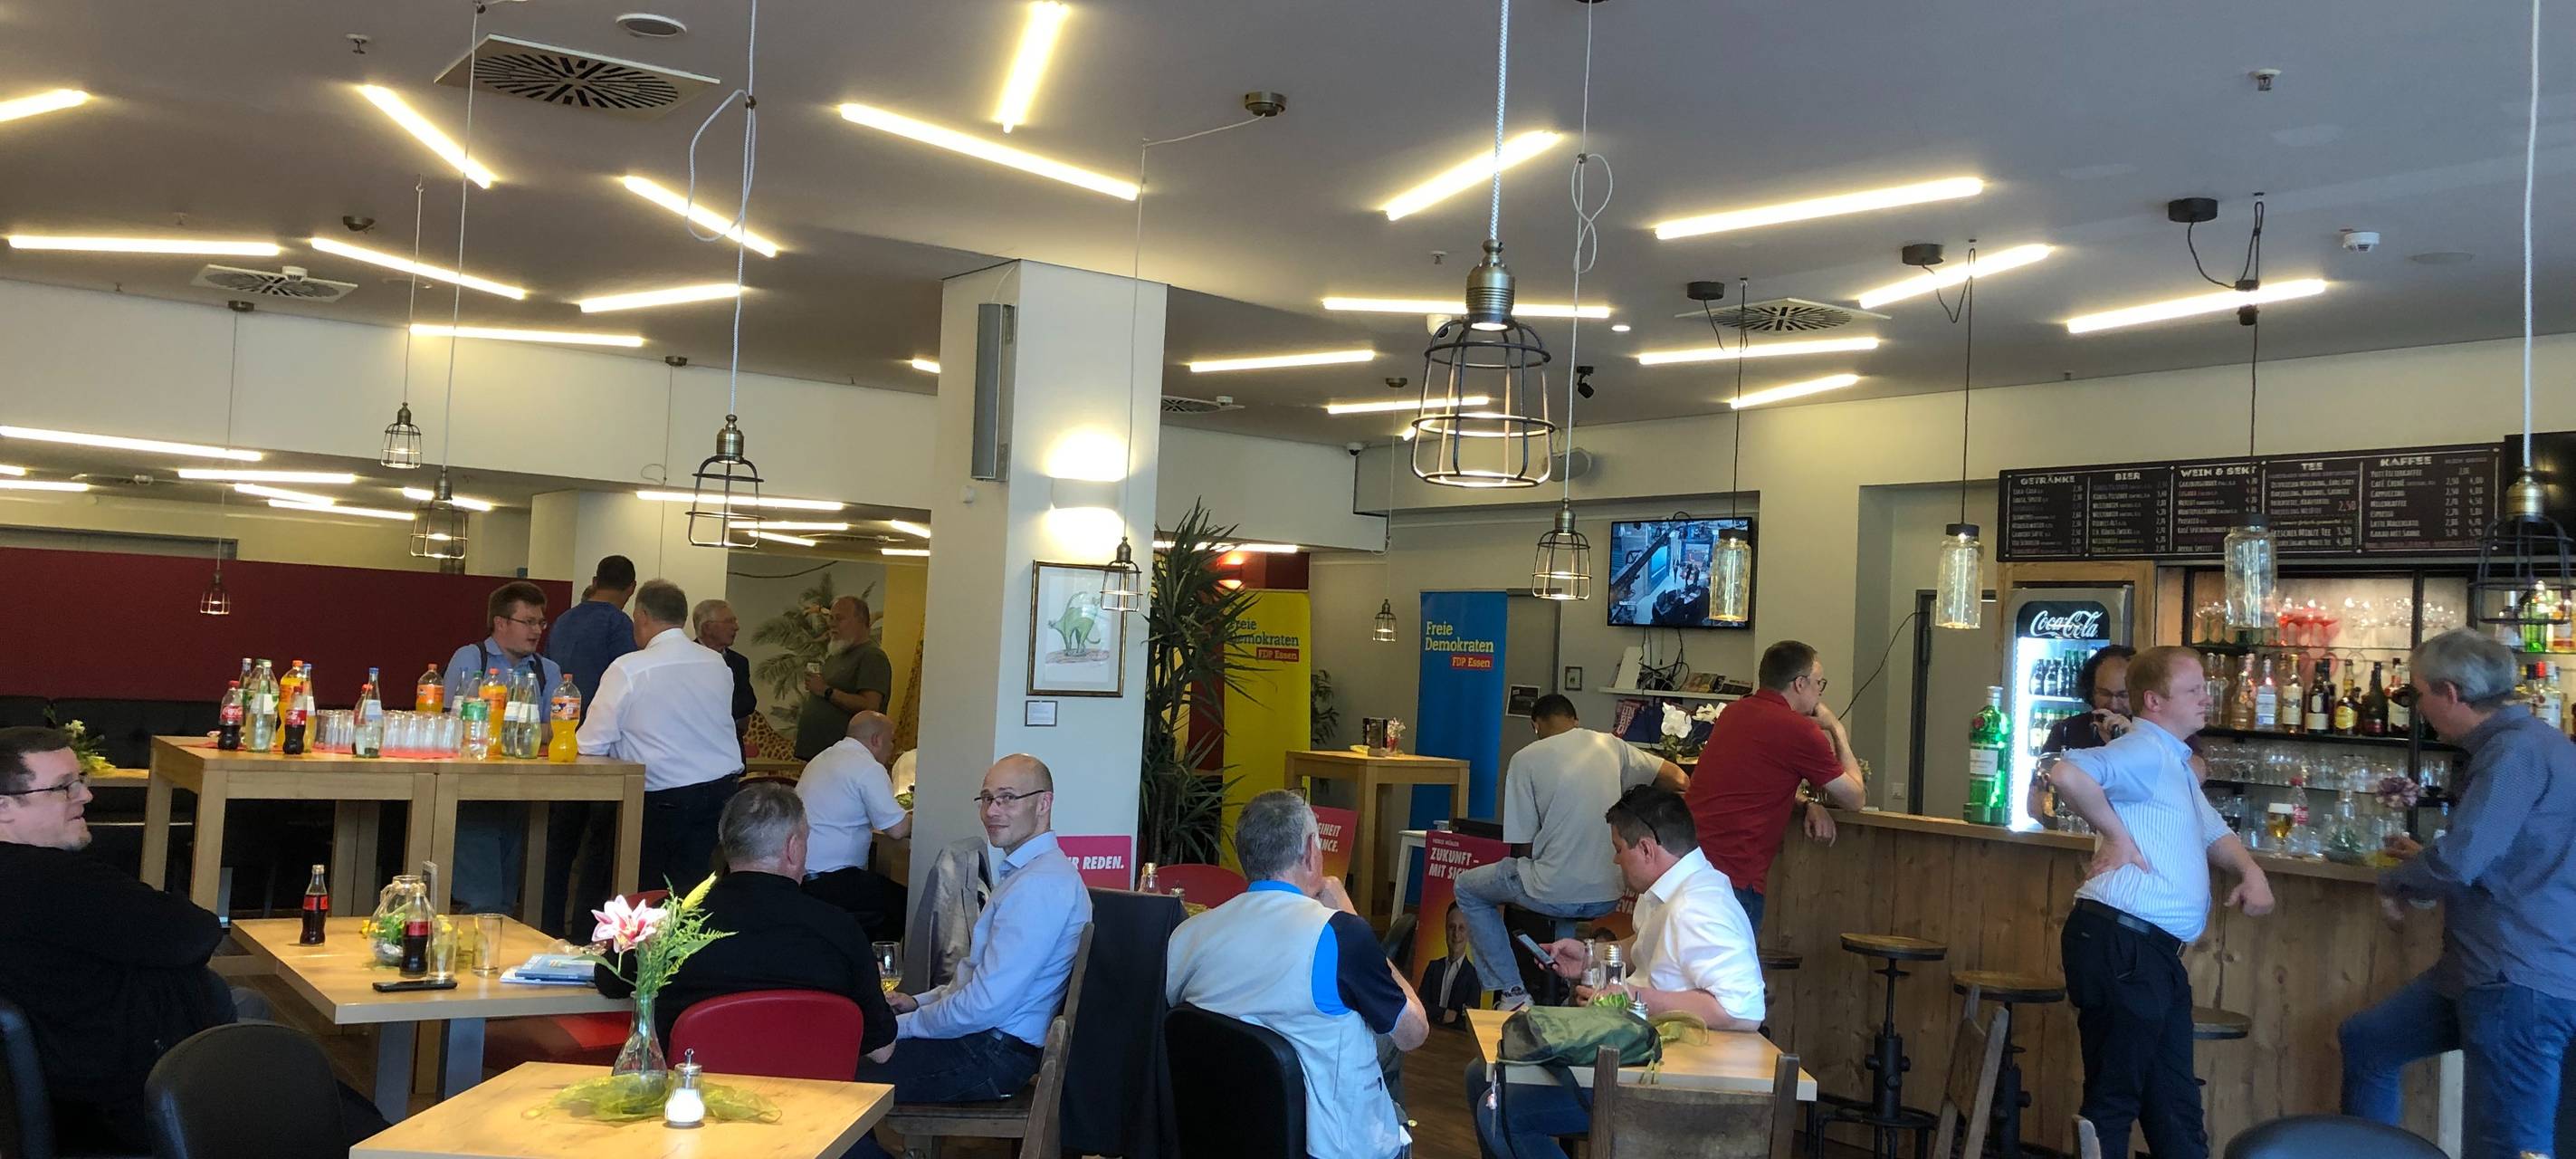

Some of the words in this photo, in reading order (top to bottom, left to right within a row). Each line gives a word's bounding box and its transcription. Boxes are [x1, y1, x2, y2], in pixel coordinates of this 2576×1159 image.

[2301, 463, 2323, 471] TEE
[2380, 456, 2432, 466] KAFFEE
[2114, 473, 2141, 481] BIER
[2180, 469, 2212, 477] WEIN
[2227, 465, 2257, 475] SEKT
[2020, 475, 2075, 485] GETRÄNKE
[1228, 618, 1256, 630] reie
[1426, 620, 1454, 636] Freie
[2030, 610, 2104, 638] Coca-Cola
[1226, 632, 1299, 646] emokraten
[1425, 637, 1494, 653] Demokraten
[1258, 649, 1274, 658] FDP
[1274, 650, 1298, 659] Essen
[1452, 656, 1466, 667] FDP
[1468, 657, 1491, 667] Essen
[1083, 856, 1124, 869] REDEN.
[1430, 847, 1473, 866] ZUKUNFT
[1428, 862, 1446, 879] MIT
